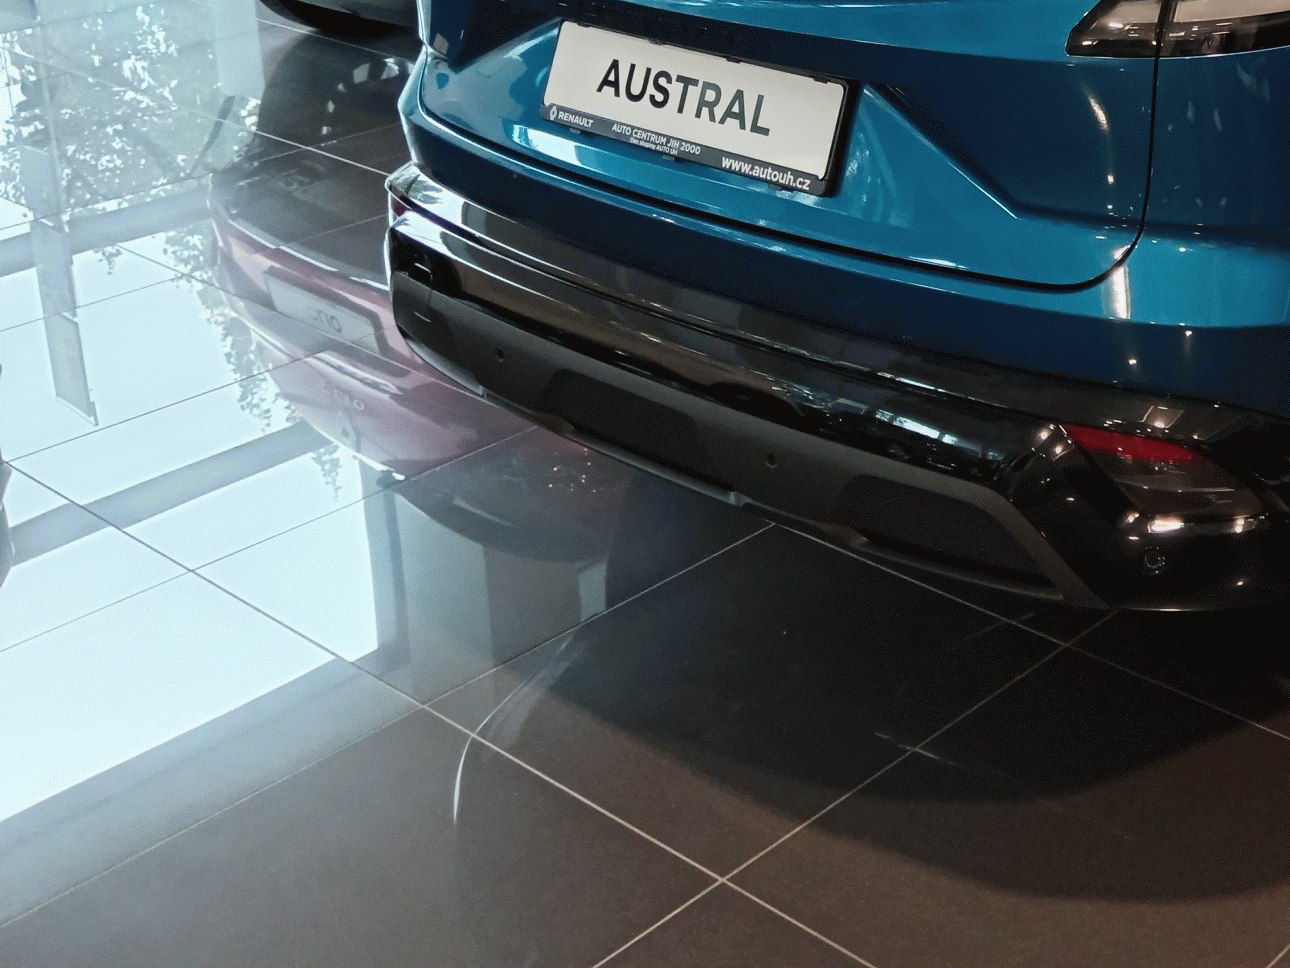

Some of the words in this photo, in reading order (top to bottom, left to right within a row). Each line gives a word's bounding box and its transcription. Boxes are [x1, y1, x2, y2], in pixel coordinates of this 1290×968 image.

[596, 58, 771, 137] AUSTRAL
[558, 111, 594, 128] RENAULT
[612, 123, 632, 136] AUTO
[632, 128, 667, 145] CENTRUM
[667, 136, 680, 148] JIH
[681, 142, 701, 155] 2000
[721, 156, 811, 191] www.autouh.cz
